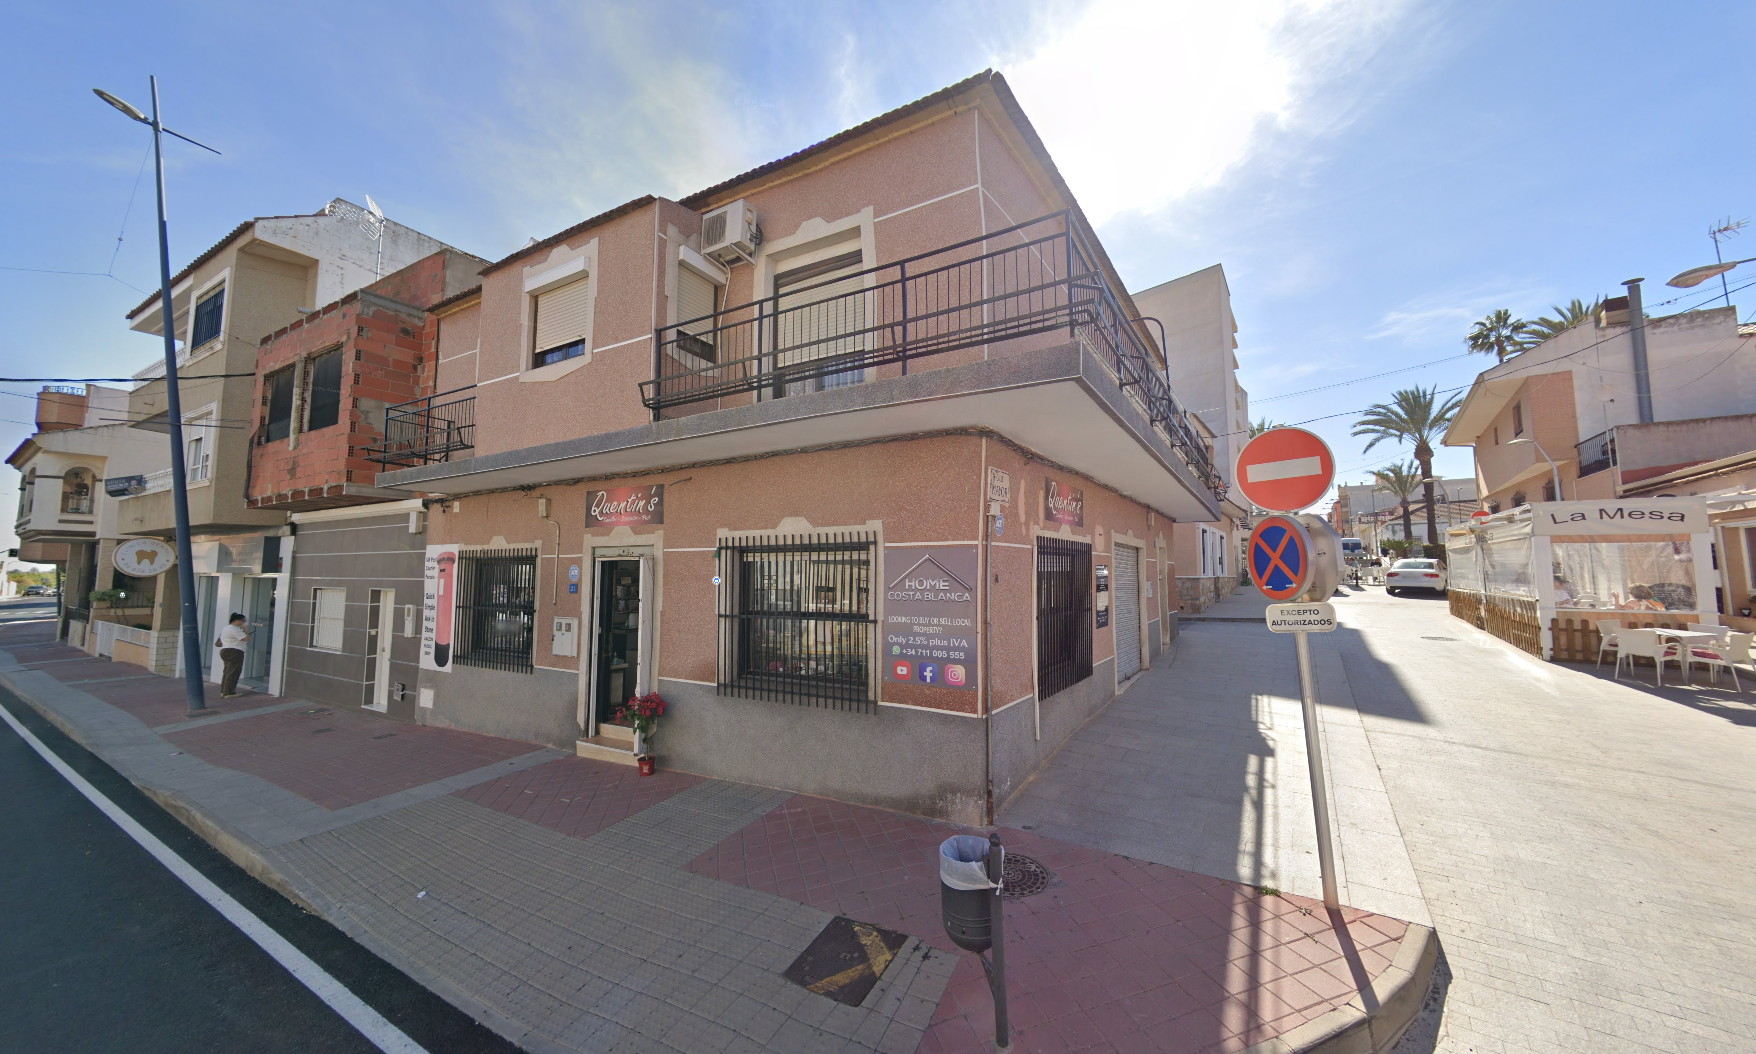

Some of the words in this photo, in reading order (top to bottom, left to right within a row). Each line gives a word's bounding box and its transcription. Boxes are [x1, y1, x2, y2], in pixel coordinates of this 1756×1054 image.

[591, 485, 659, 521] Quentin's
[1049, 481, 1082, 514] Quentin's
[1550, 511, 1587, 525] La
[1598, 507, 1686, 522] Mesa
[905, 578, 950, 590] HOME
[888, 592, 922, 601] COSTA
[924, 592, 971, 602] BLANCA
[425, 603, 435, 612] Simple
[1280, 608, 1320, 616] EXCEPTO
[911, 616, 919, 624] TO
[919, 616, 930, 624] BUY
[930, 617, 939, 625] OR
[939, 618, 952, 626] SELL
[952, 618, 972, 626] LOCAL
[913, 625, 943, 634] PROPERTY?
[888, 634, 907, 645] Only
[929, 638, 948, 647] plus
[950, 638, 969, 647] IVA
[902, 648, 916, 656] +34
[932, 650, 948, 658] 005
[949, 651, 965, 660] 555
